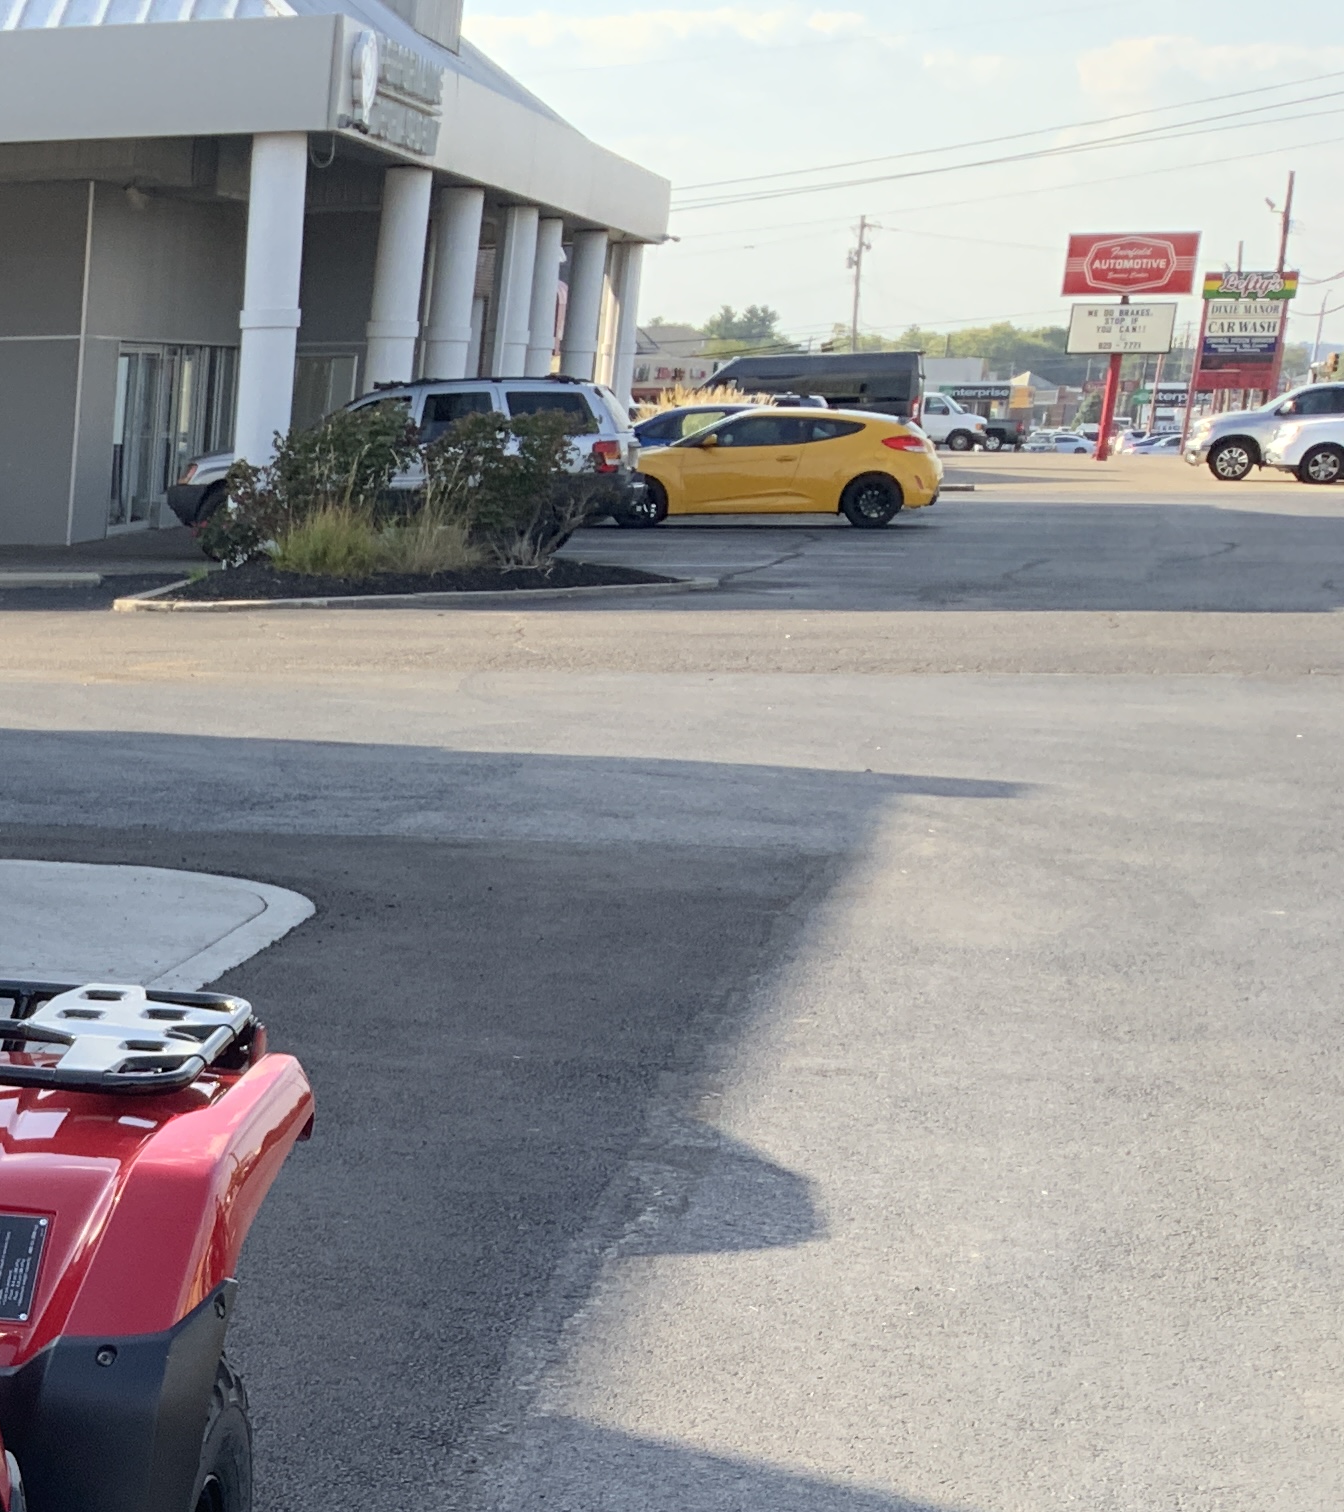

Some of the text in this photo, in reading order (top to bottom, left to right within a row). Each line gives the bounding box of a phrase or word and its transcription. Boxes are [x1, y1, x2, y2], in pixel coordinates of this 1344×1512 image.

[1092, 258, 1167, 269] AUTOMOTIVE
[1219, 273, 1284, 297] Lefty's
[1103, 309, 1114, 317] DO
[1211, 304, 1280, 314] DIXIE MANOR
[1104, 317, 1138, 325] STOP IF
[1096, 325, 1112, 333] YOU
[1208, 320, 1277, 333] CAR WASH
